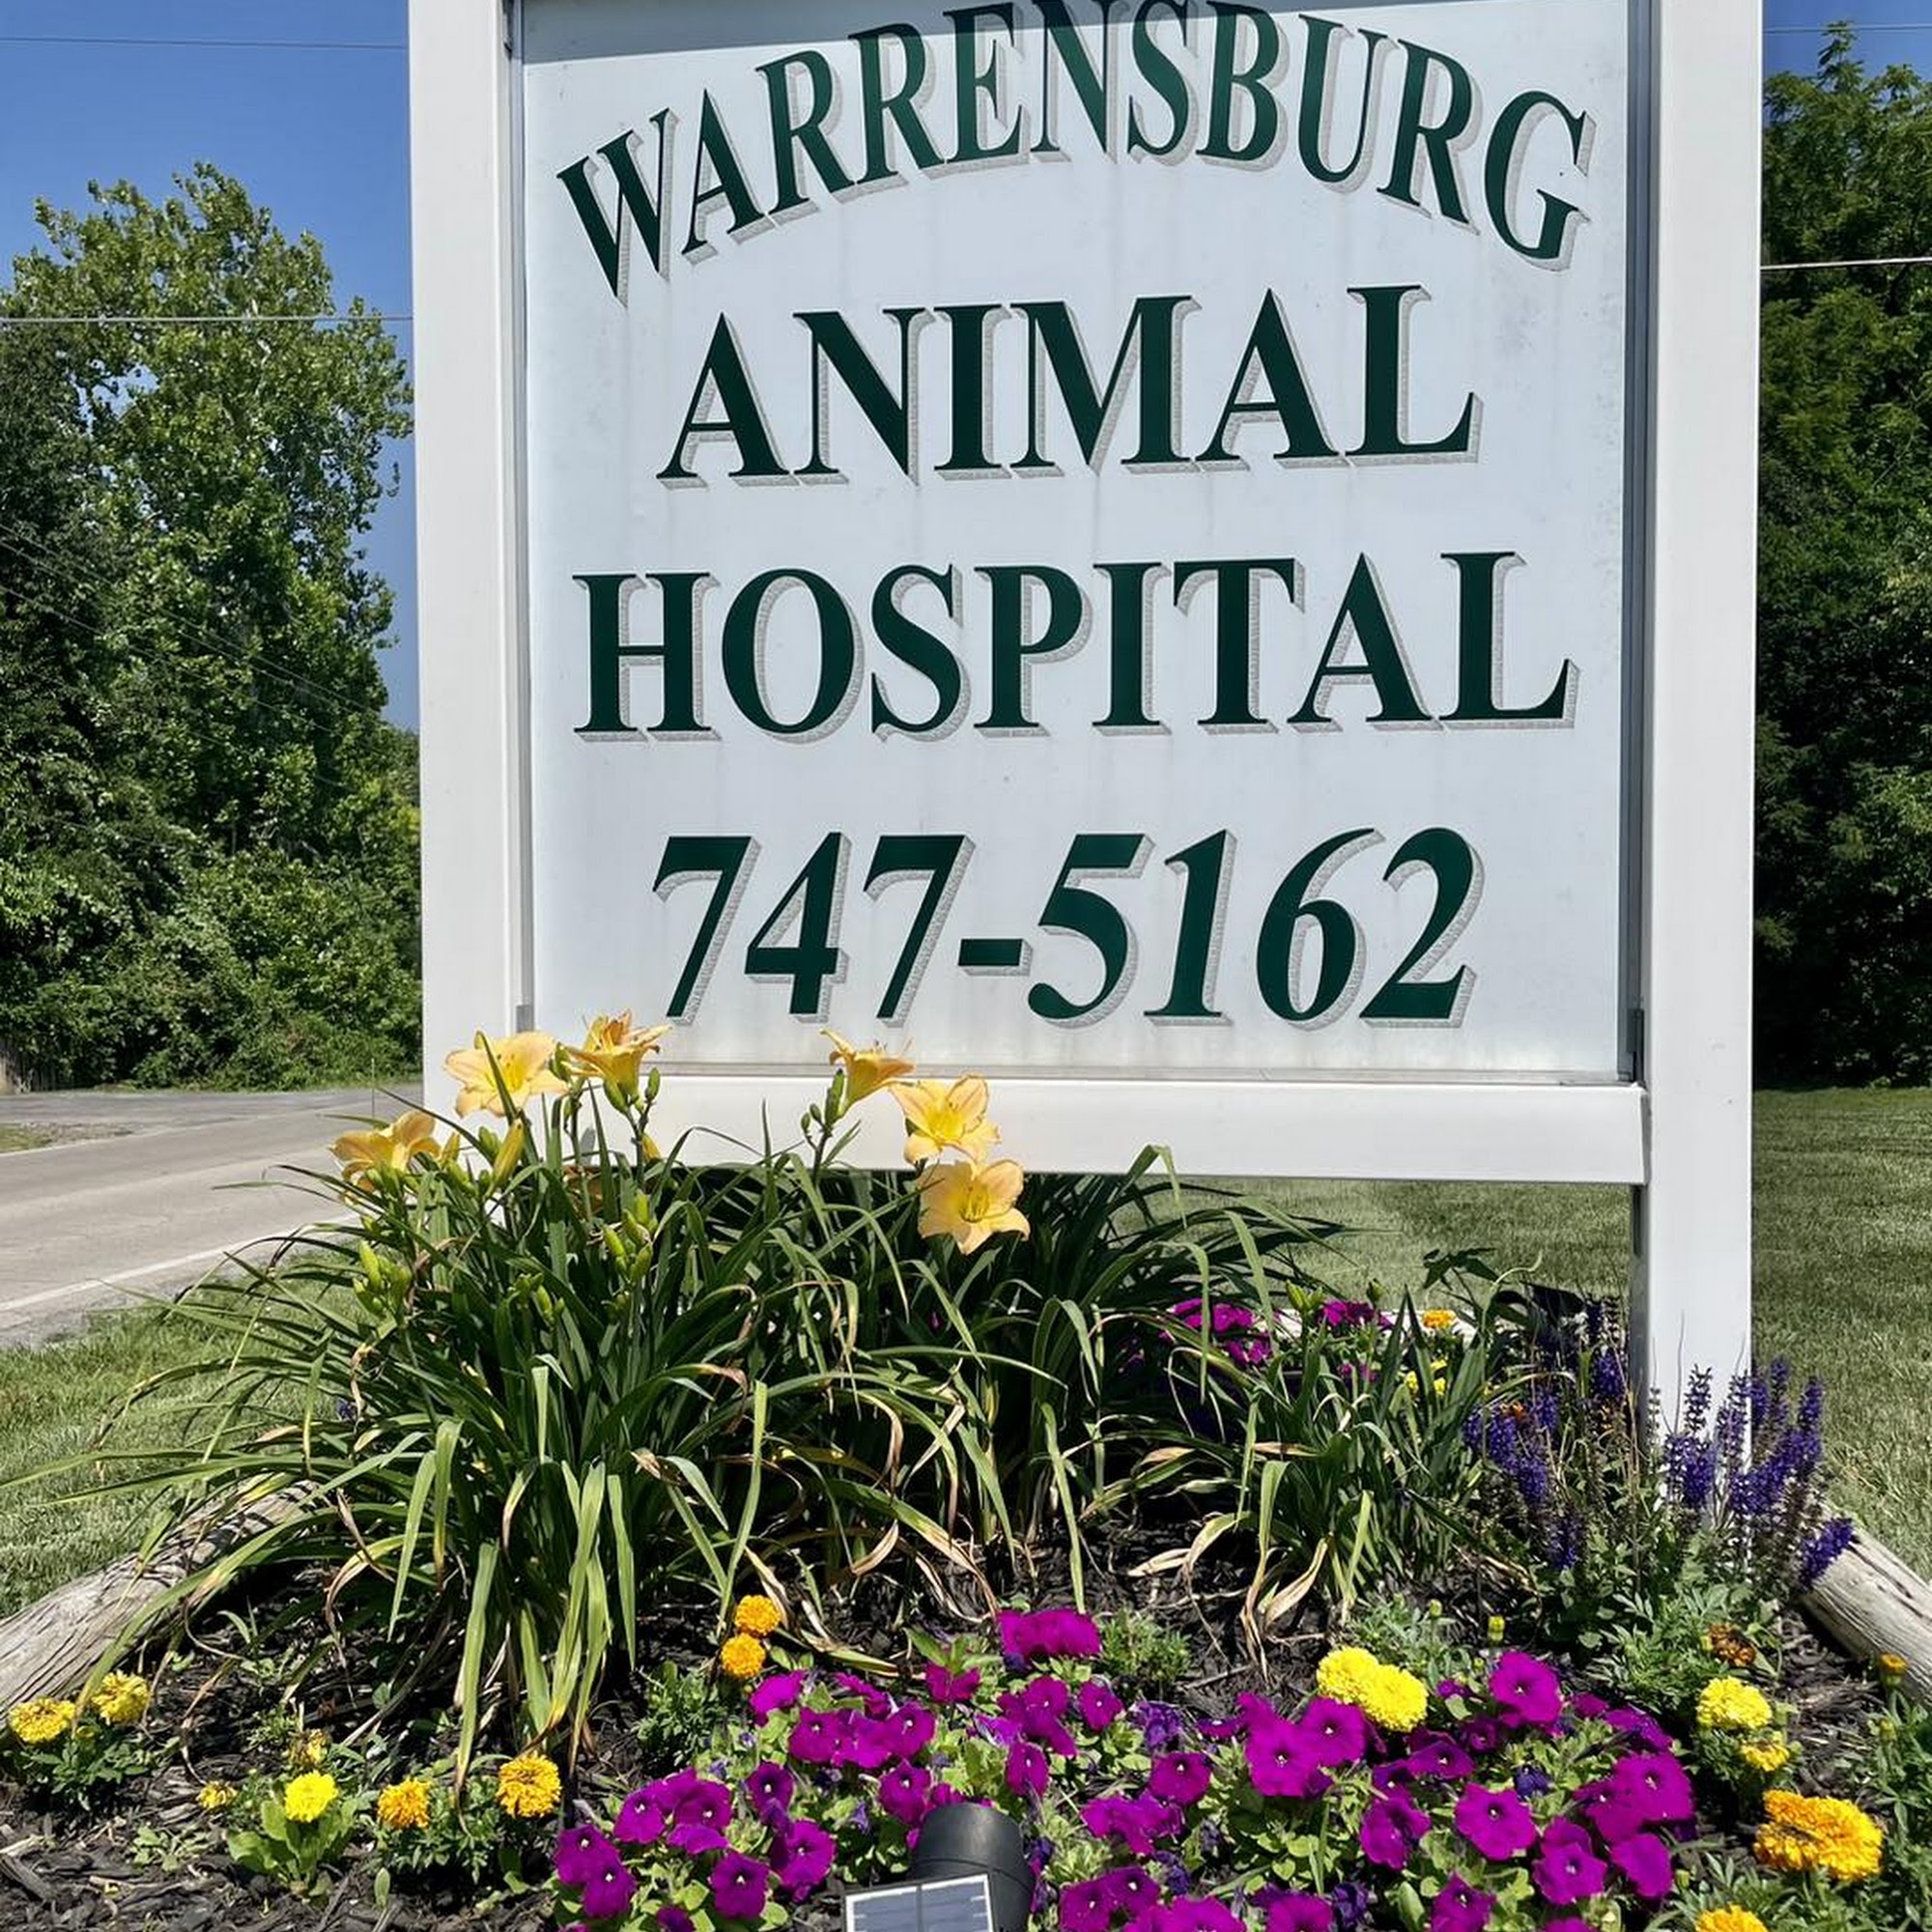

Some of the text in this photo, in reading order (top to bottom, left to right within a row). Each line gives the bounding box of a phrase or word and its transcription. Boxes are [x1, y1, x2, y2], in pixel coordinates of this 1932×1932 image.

[557, 0, 1592, 299] WARRENSBURG
[658, 286, 1481, 480] ANIMAL
[574, 553, 1576, 734] HOSPITAL
[652, 828, 1480, 1023] 747-5162
